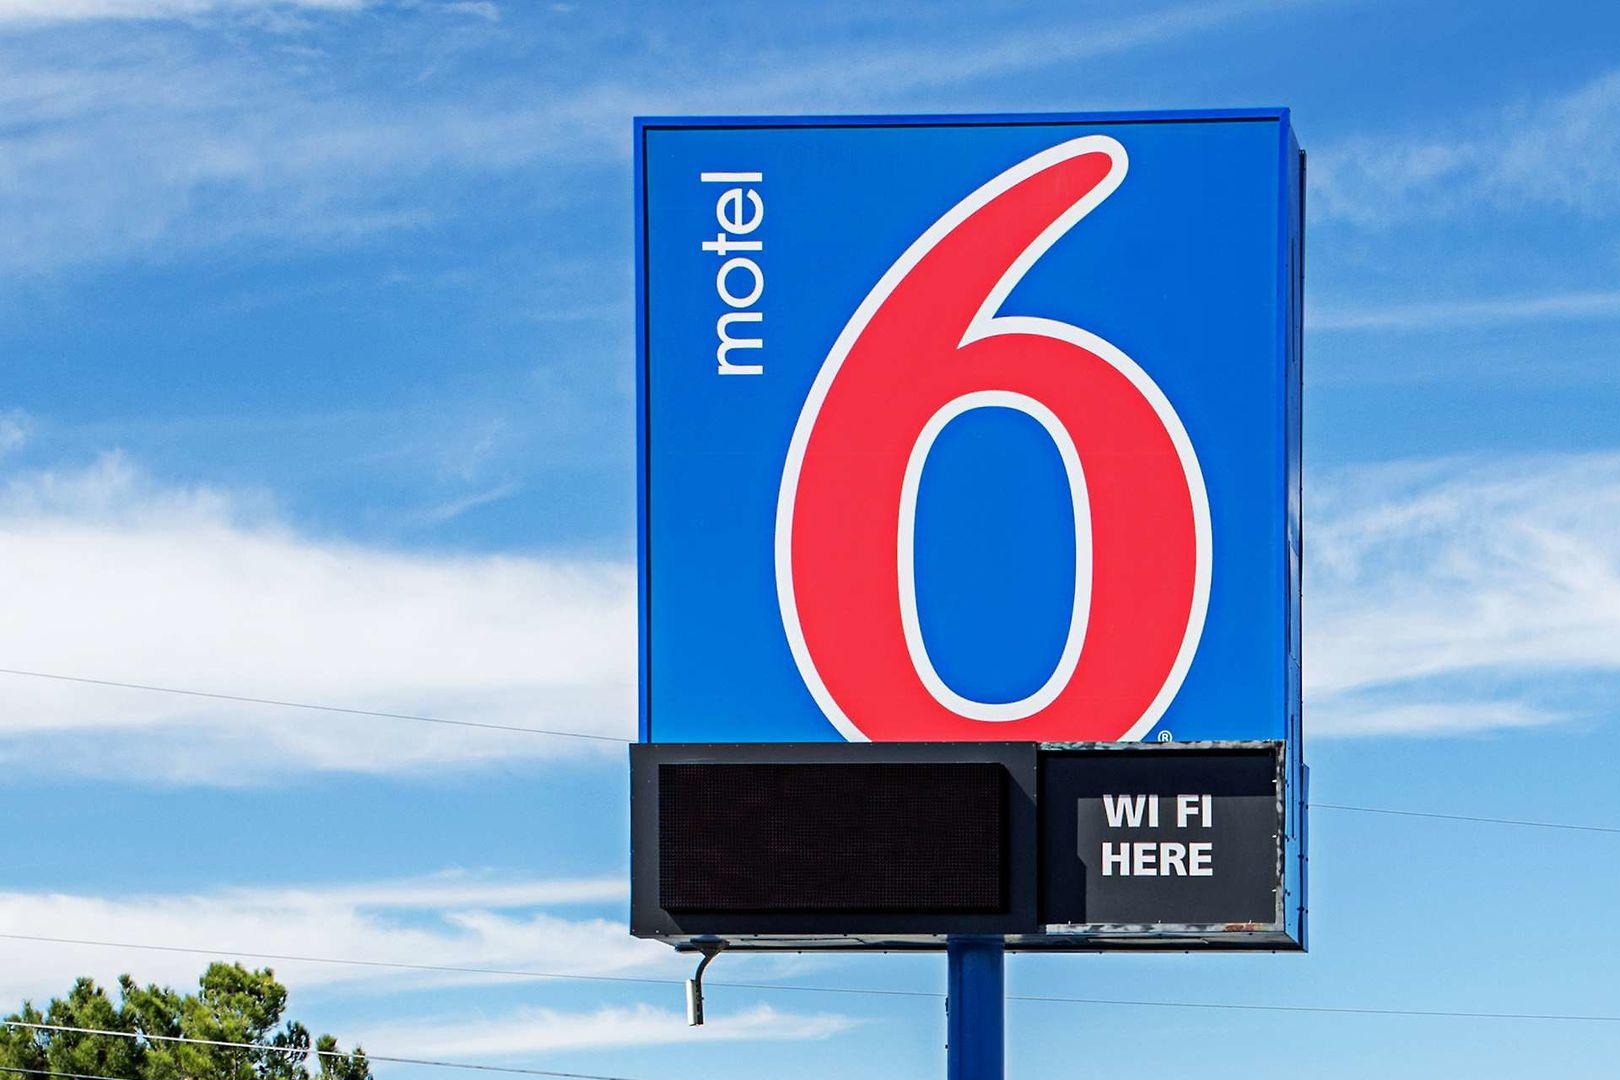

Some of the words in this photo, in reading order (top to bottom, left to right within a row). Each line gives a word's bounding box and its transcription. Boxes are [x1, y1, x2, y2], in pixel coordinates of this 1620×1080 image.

[701, 171, 763, 376] motel
[774, 134, 1213, 743] 6
[1101, 843, 1213, 877] HERE
[1102, 794, 1159, 828] WI
[1176, 794, 1213, 828] FI
